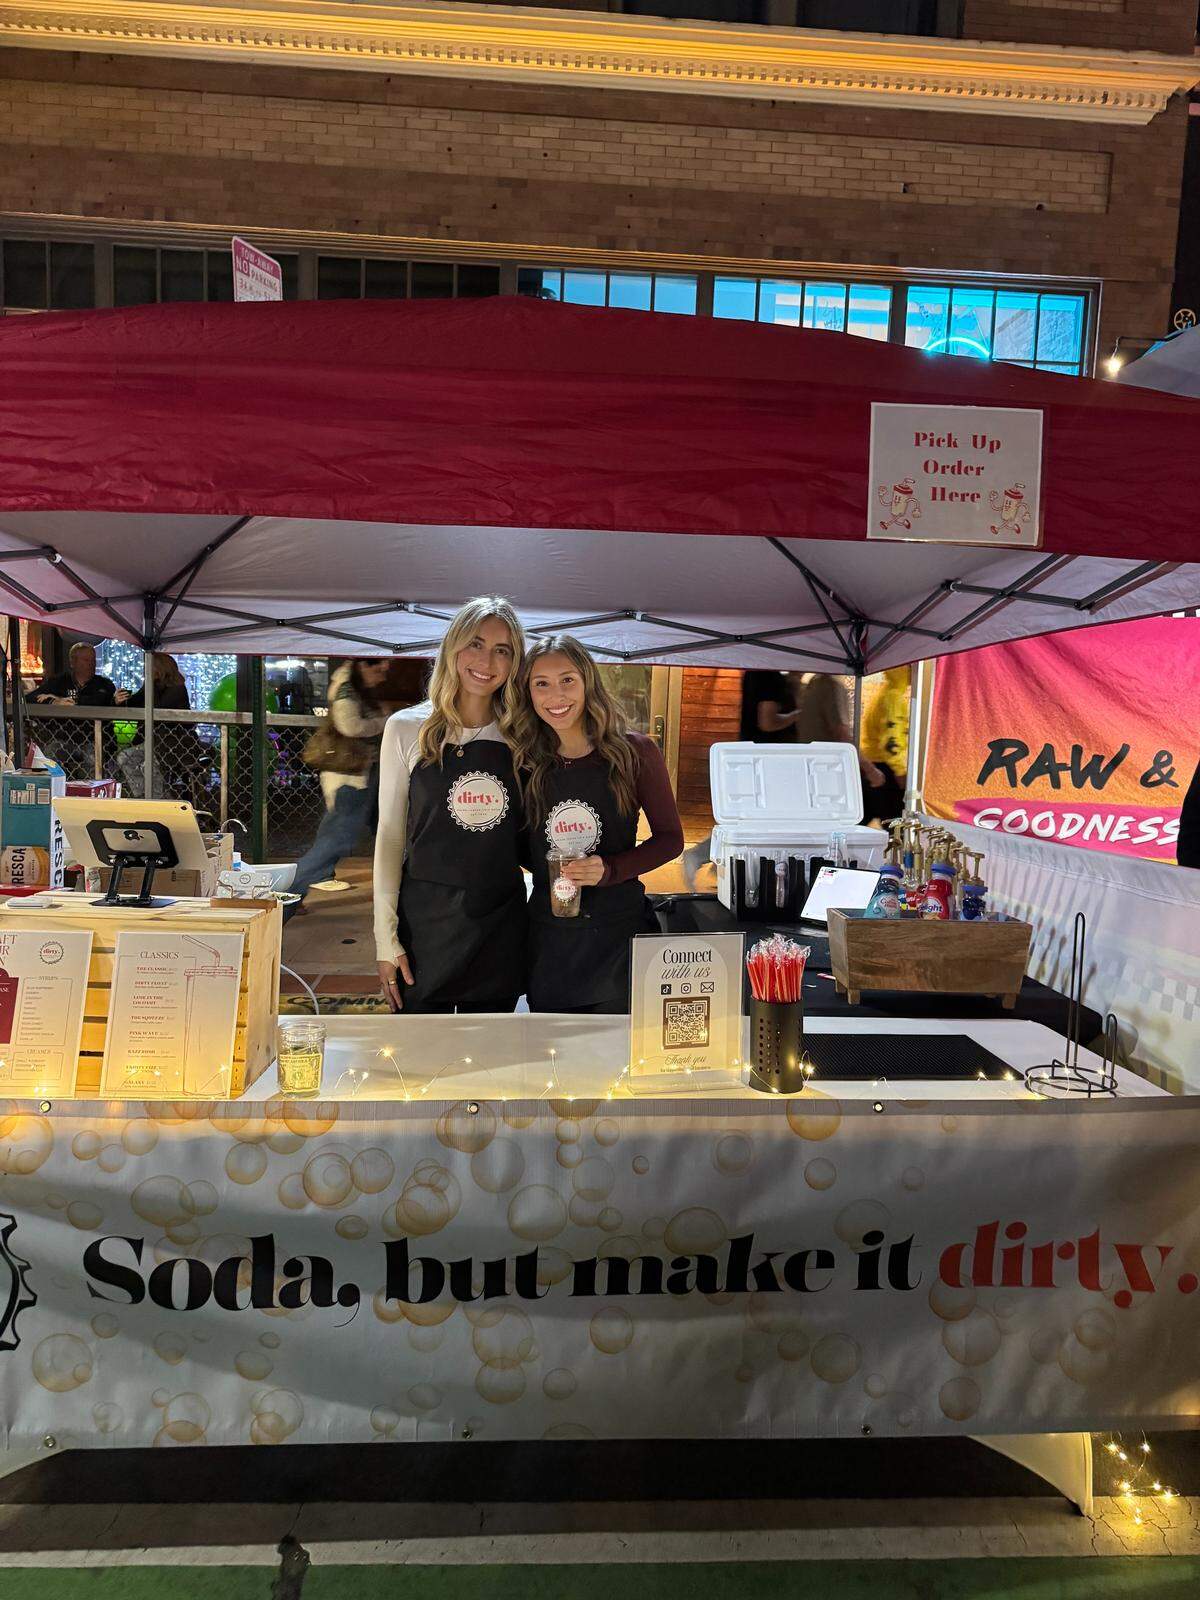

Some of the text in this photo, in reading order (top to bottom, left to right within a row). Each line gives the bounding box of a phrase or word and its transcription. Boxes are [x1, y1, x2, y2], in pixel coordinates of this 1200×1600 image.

[235, 255, 248, 274] NO
[914, 432, 1001, 453] Pick Up
[923, 460, 985, 477] Order
[930, 486, 981, 503] Here
[977, 738, 1180, 790] RAW &
[457, 791, 499, 805] dirty.
[554, 821, 593, 834] dirty.
[973, 807, 1181, 846] GOODNESS
[140, 951, 179, 960] CLASSICS
[663, 948, 712, 964] Connect
[661, 963, 712, 980] with us
[82, 1219, 1200, 1329] Soda, but make it dirty.
